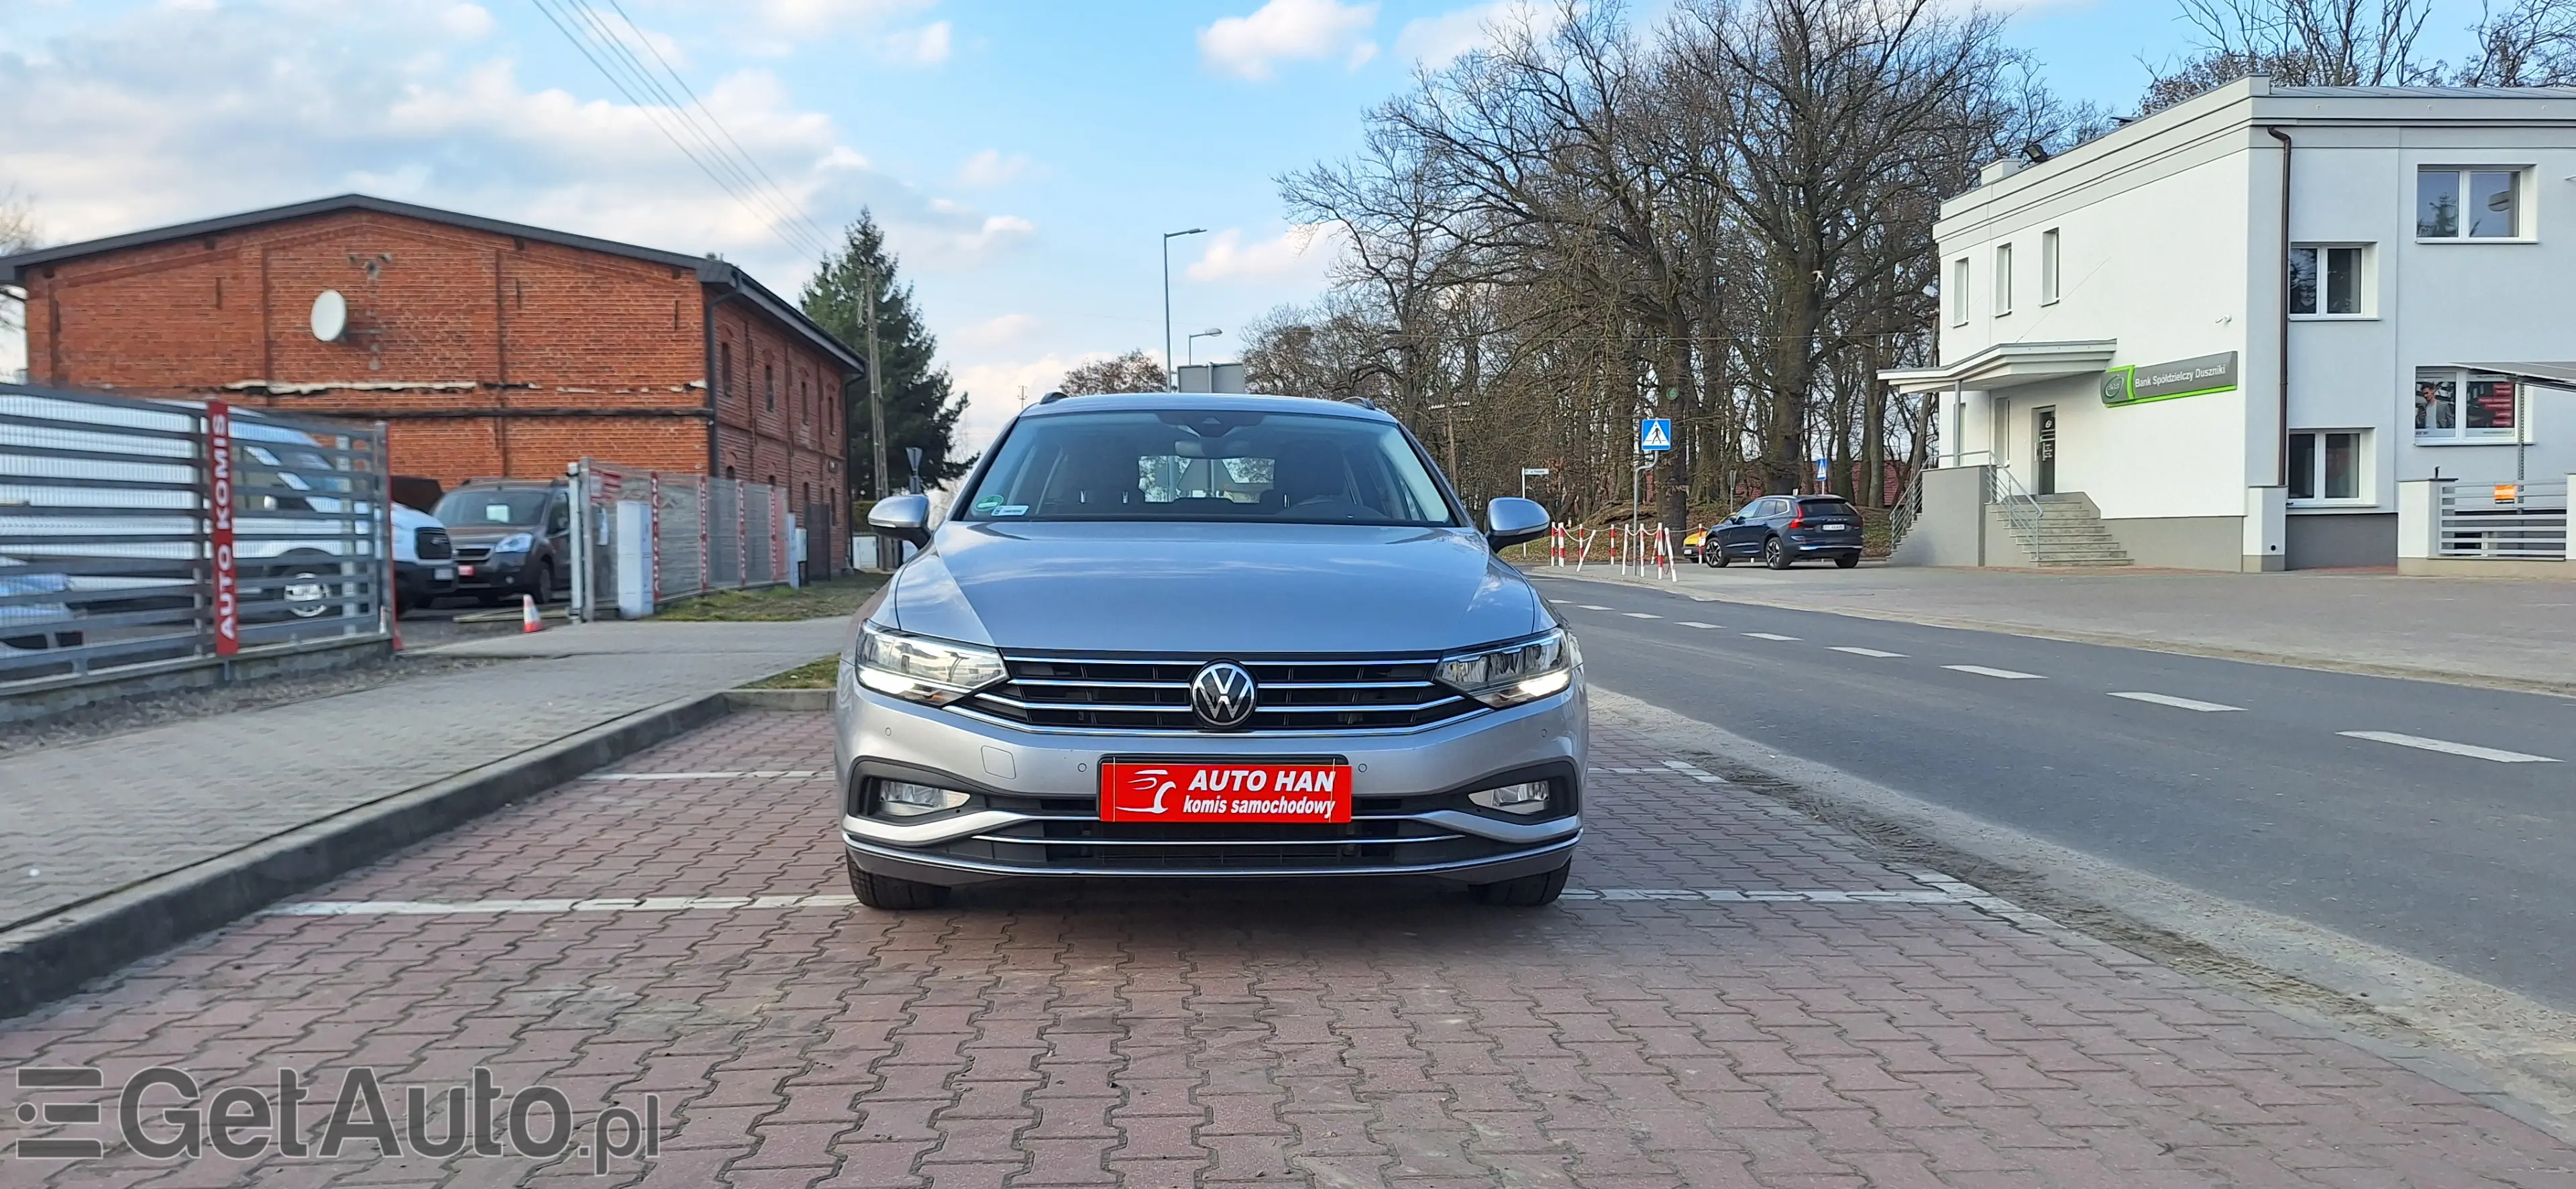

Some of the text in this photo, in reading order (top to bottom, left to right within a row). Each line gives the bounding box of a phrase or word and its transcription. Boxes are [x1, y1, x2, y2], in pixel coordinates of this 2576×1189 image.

[2135, 376, 2151, 388] Bank
[2152, 372, 2194, 387] Spółdzielczy
[2195, 365, 2226, 378] Duszniki
[212, 414, 235, 640] AUTO KOMIS
[1187, 770, 1336, 793] AUTO HAN
[1183, 795, 1336, 819] komis samochodowy
